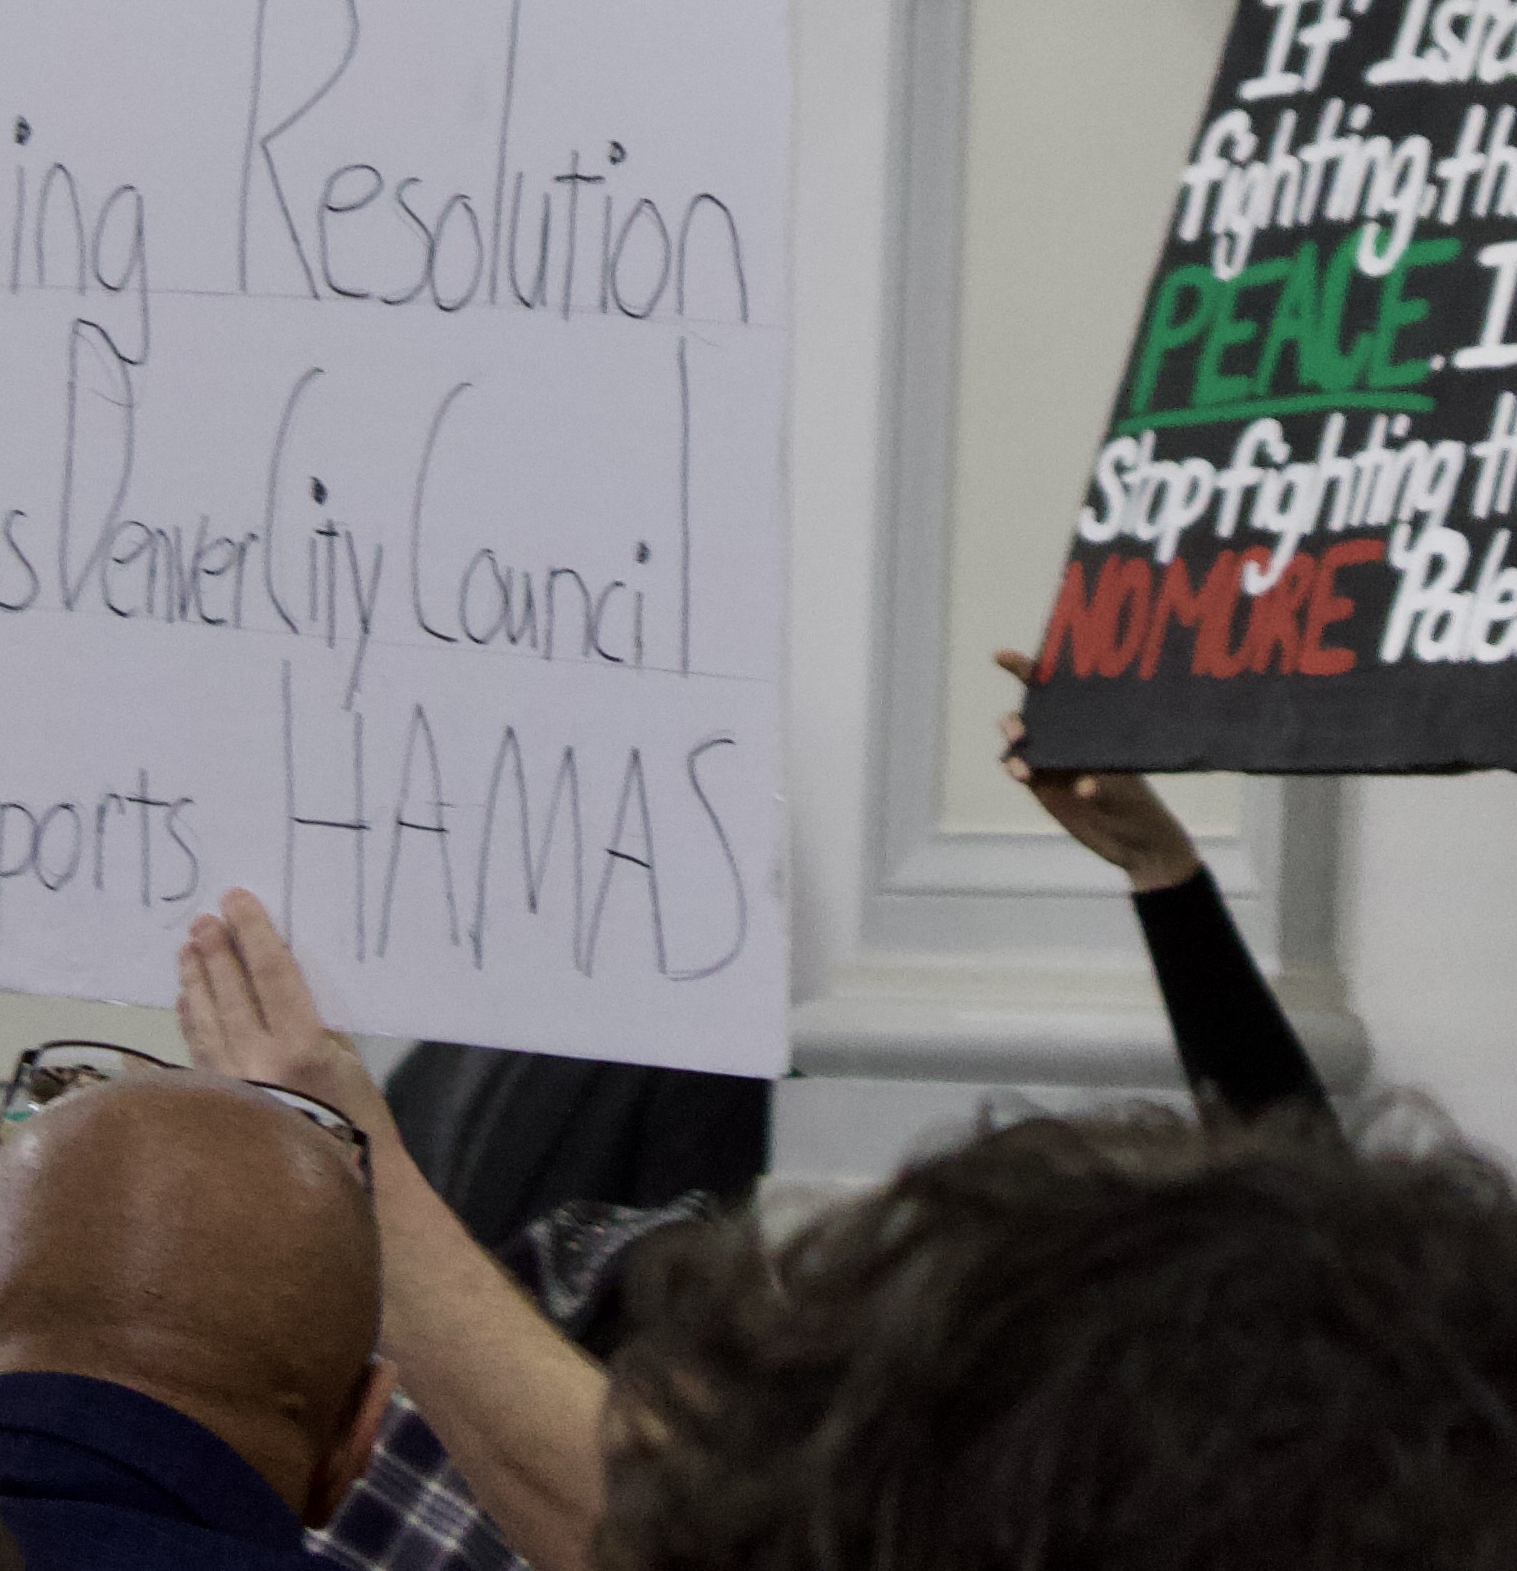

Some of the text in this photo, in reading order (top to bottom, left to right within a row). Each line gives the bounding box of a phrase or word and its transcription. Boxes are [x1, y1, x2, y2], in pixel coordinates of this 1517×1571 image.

[58, 317, 259, 630] Denver
[263, 366, 384, 711] City
[413, 336, 691, 679] Council
[1078, 427, 1216, 564] Stop
[1214, 413, 1466, 595] fighting
[283, 658, 748, 982] HAMAS
